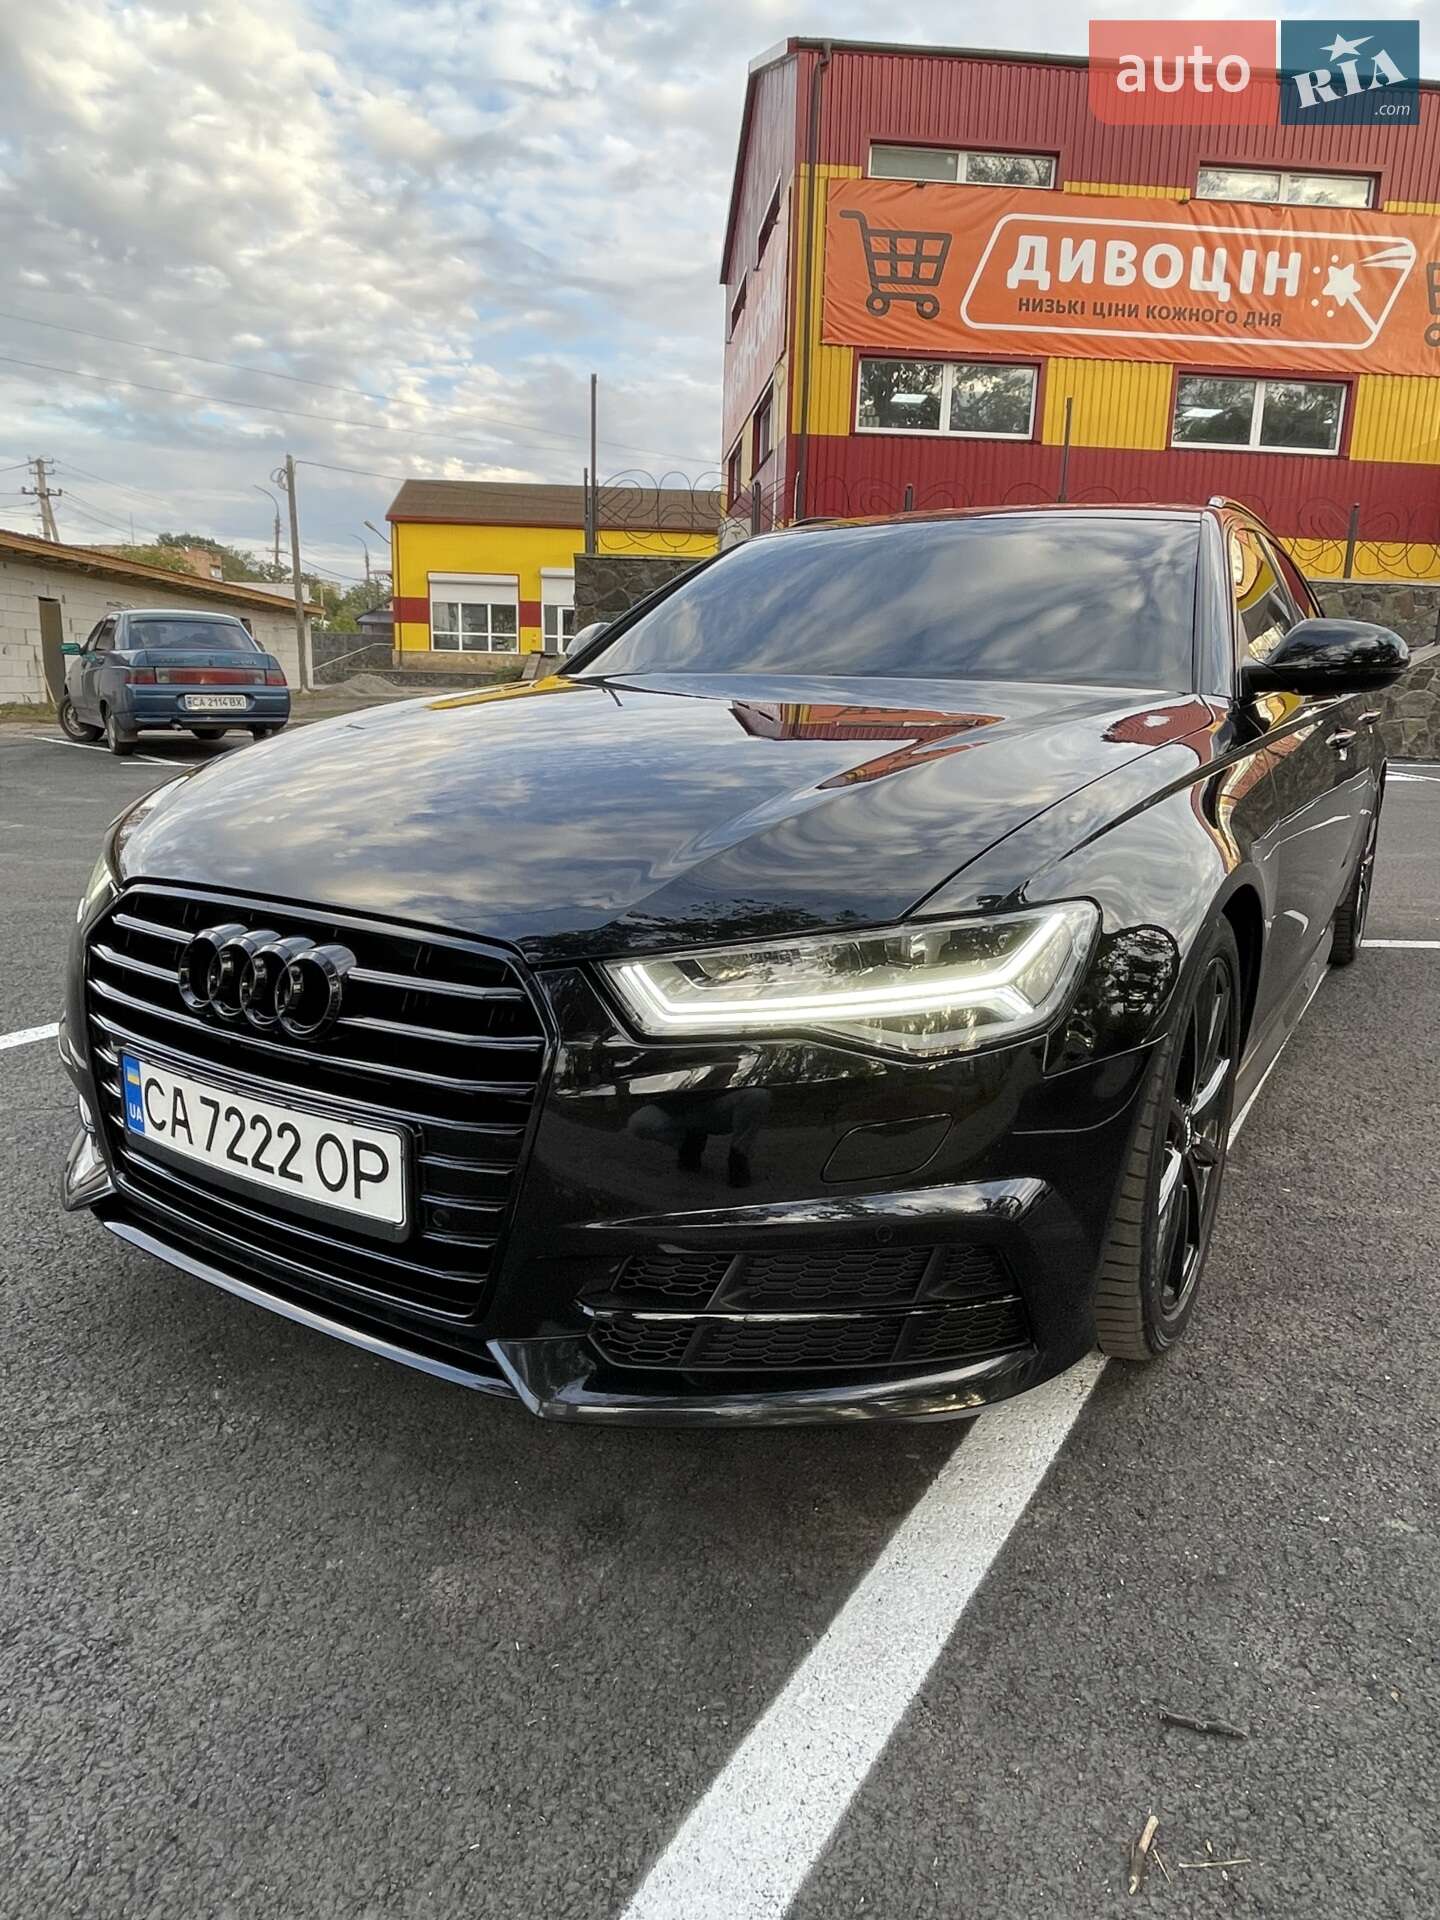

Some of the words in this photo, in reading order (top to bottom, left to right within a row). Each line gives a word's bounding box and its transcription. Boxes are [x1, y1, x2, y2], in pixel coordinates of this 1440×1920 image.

[1007, 235, 1302, 303] ДИВОЦІН
[1018, 297, 1085, 315] НИЗЬКІ
[1092, 300, 1140, 319] ЦІНИ
[1146, 305, 1237, 325] КОЖНОГО
[1243, 311, 1282, 328] ДНЯ
[128, 1103, 143, 1123] UA
[144, 1077, 194, 1145] CA
[200, 1095, 304, 1184] 7222
[315, 1132, 390, 1200] OP
